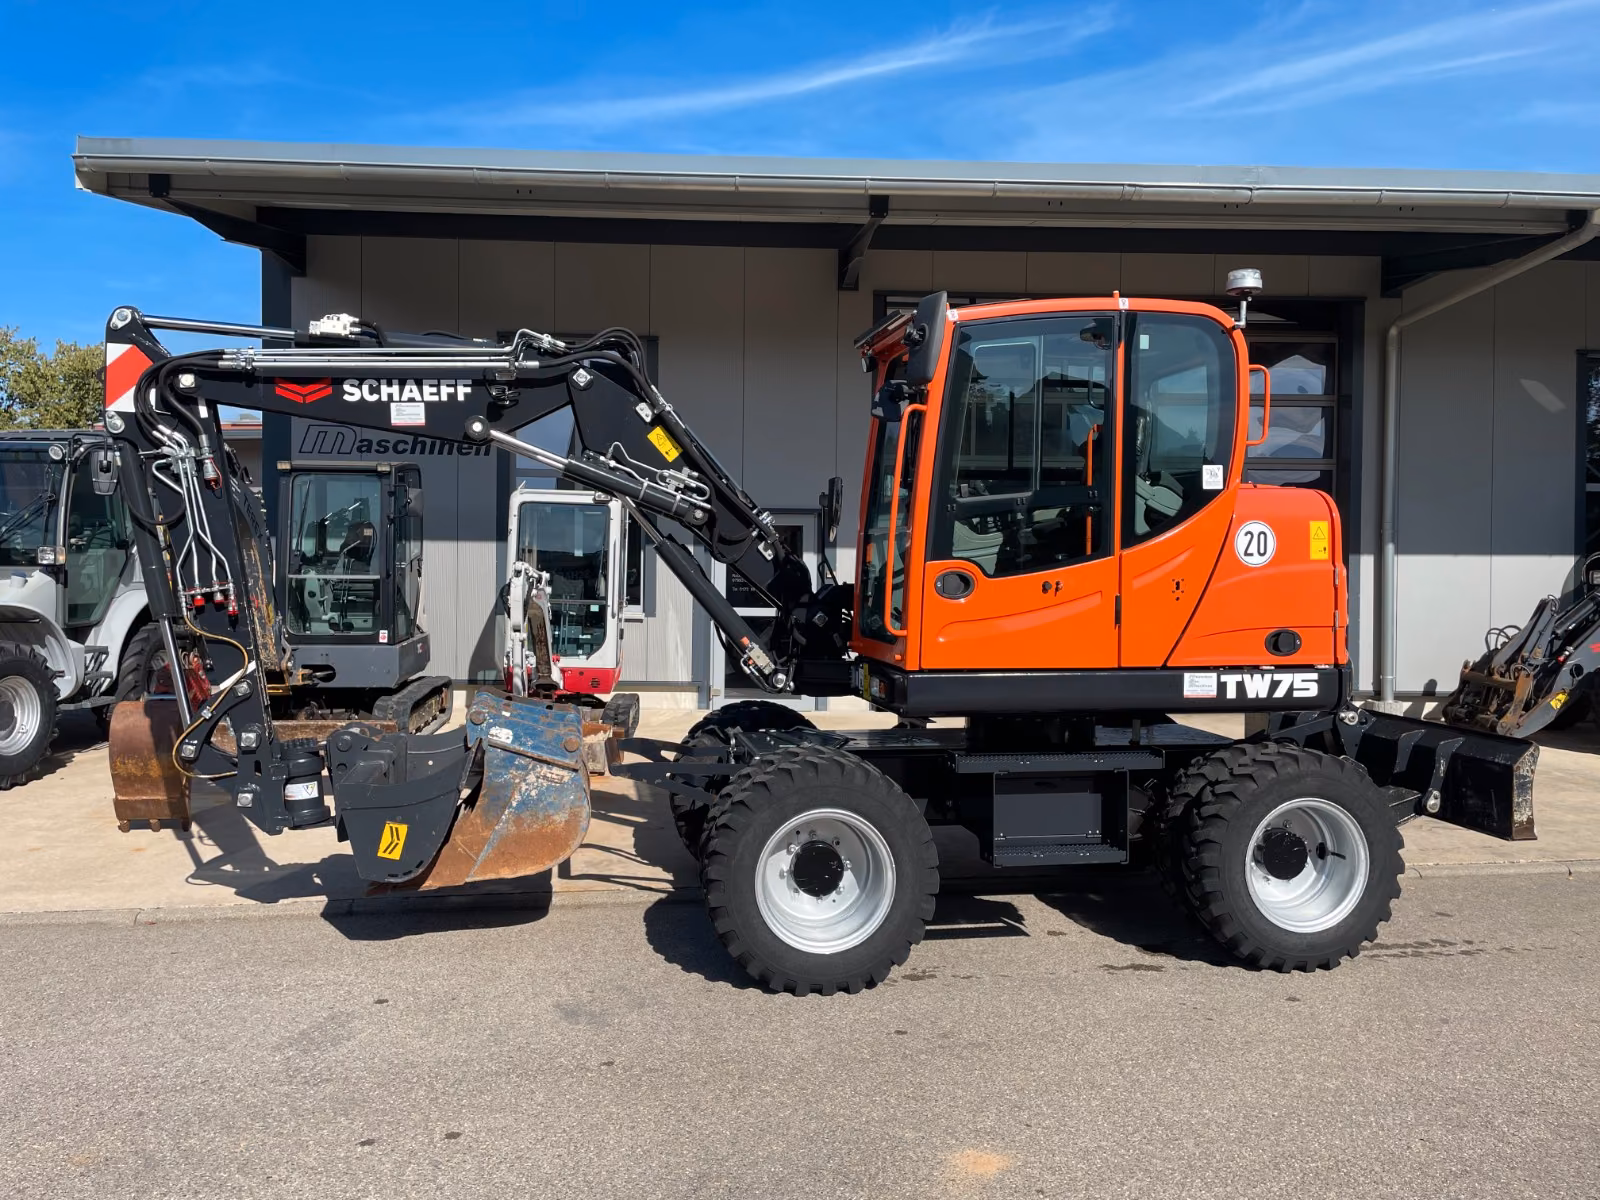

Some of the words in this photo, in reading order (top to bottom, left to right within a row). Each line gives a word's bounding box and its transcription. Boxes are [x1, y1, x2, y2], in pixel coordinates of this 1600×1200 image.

[342, 378, 472, 401] SCHAEFF
[1243, 530, 1268, 557] 20
[1220, 672, 1319, 699] TW75
